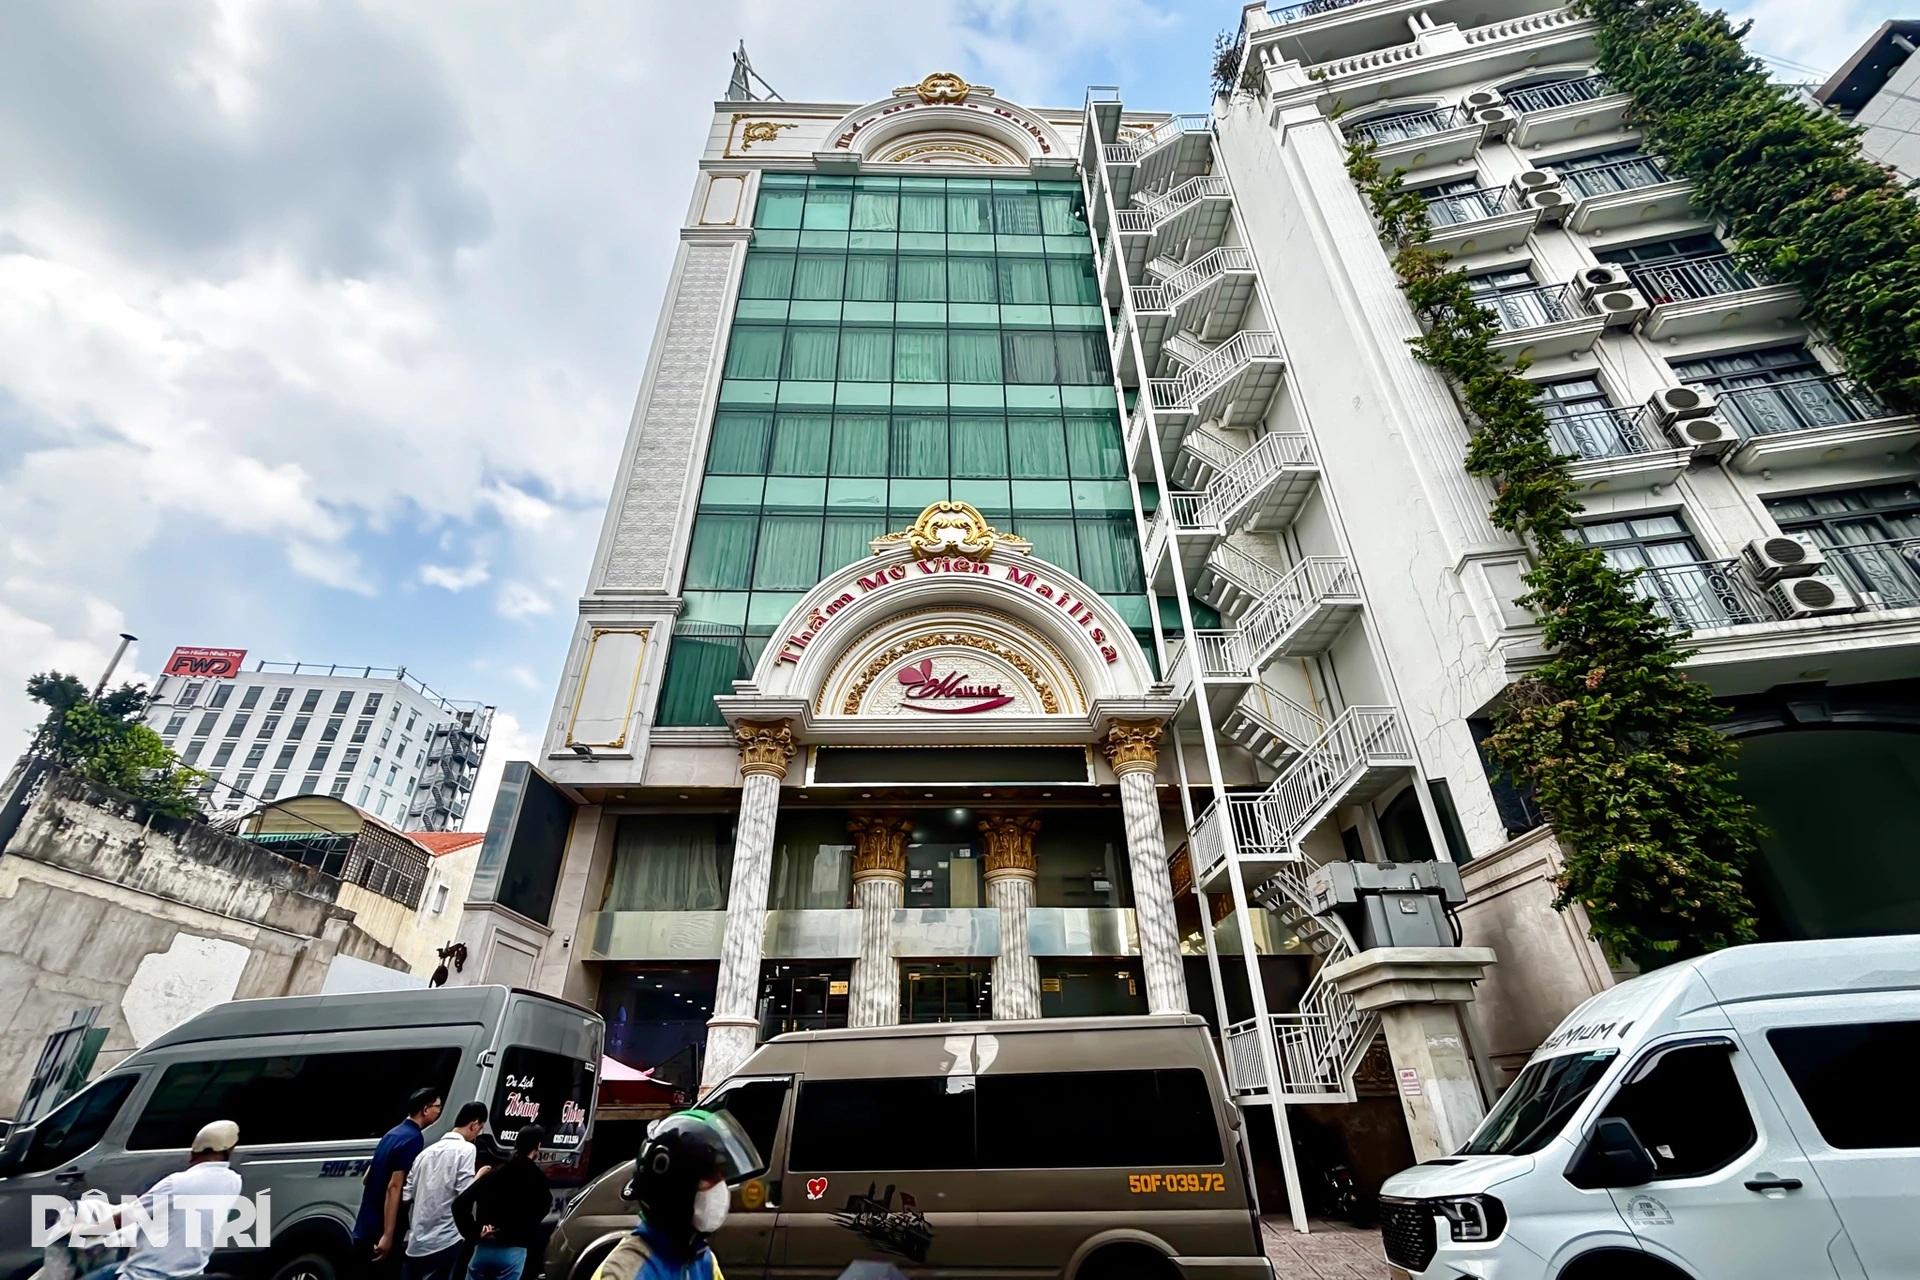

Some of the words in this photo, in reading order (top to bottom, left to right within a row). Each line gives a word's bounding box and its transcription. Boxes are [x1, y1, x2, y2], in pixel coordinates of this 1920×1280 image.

[776, 593, 856, 665] Thẩm
[1005, 565, 1119, 664] Mailisa
[172, 656, 231, 674] FWD
[505, 1074, 518, 1087] Du
[518, 1074, 535, 1089] Lịch
[504, 1091, 540, 1123] Hoàng
[1128, 1173, 1226, 1193] 50F-039.72
